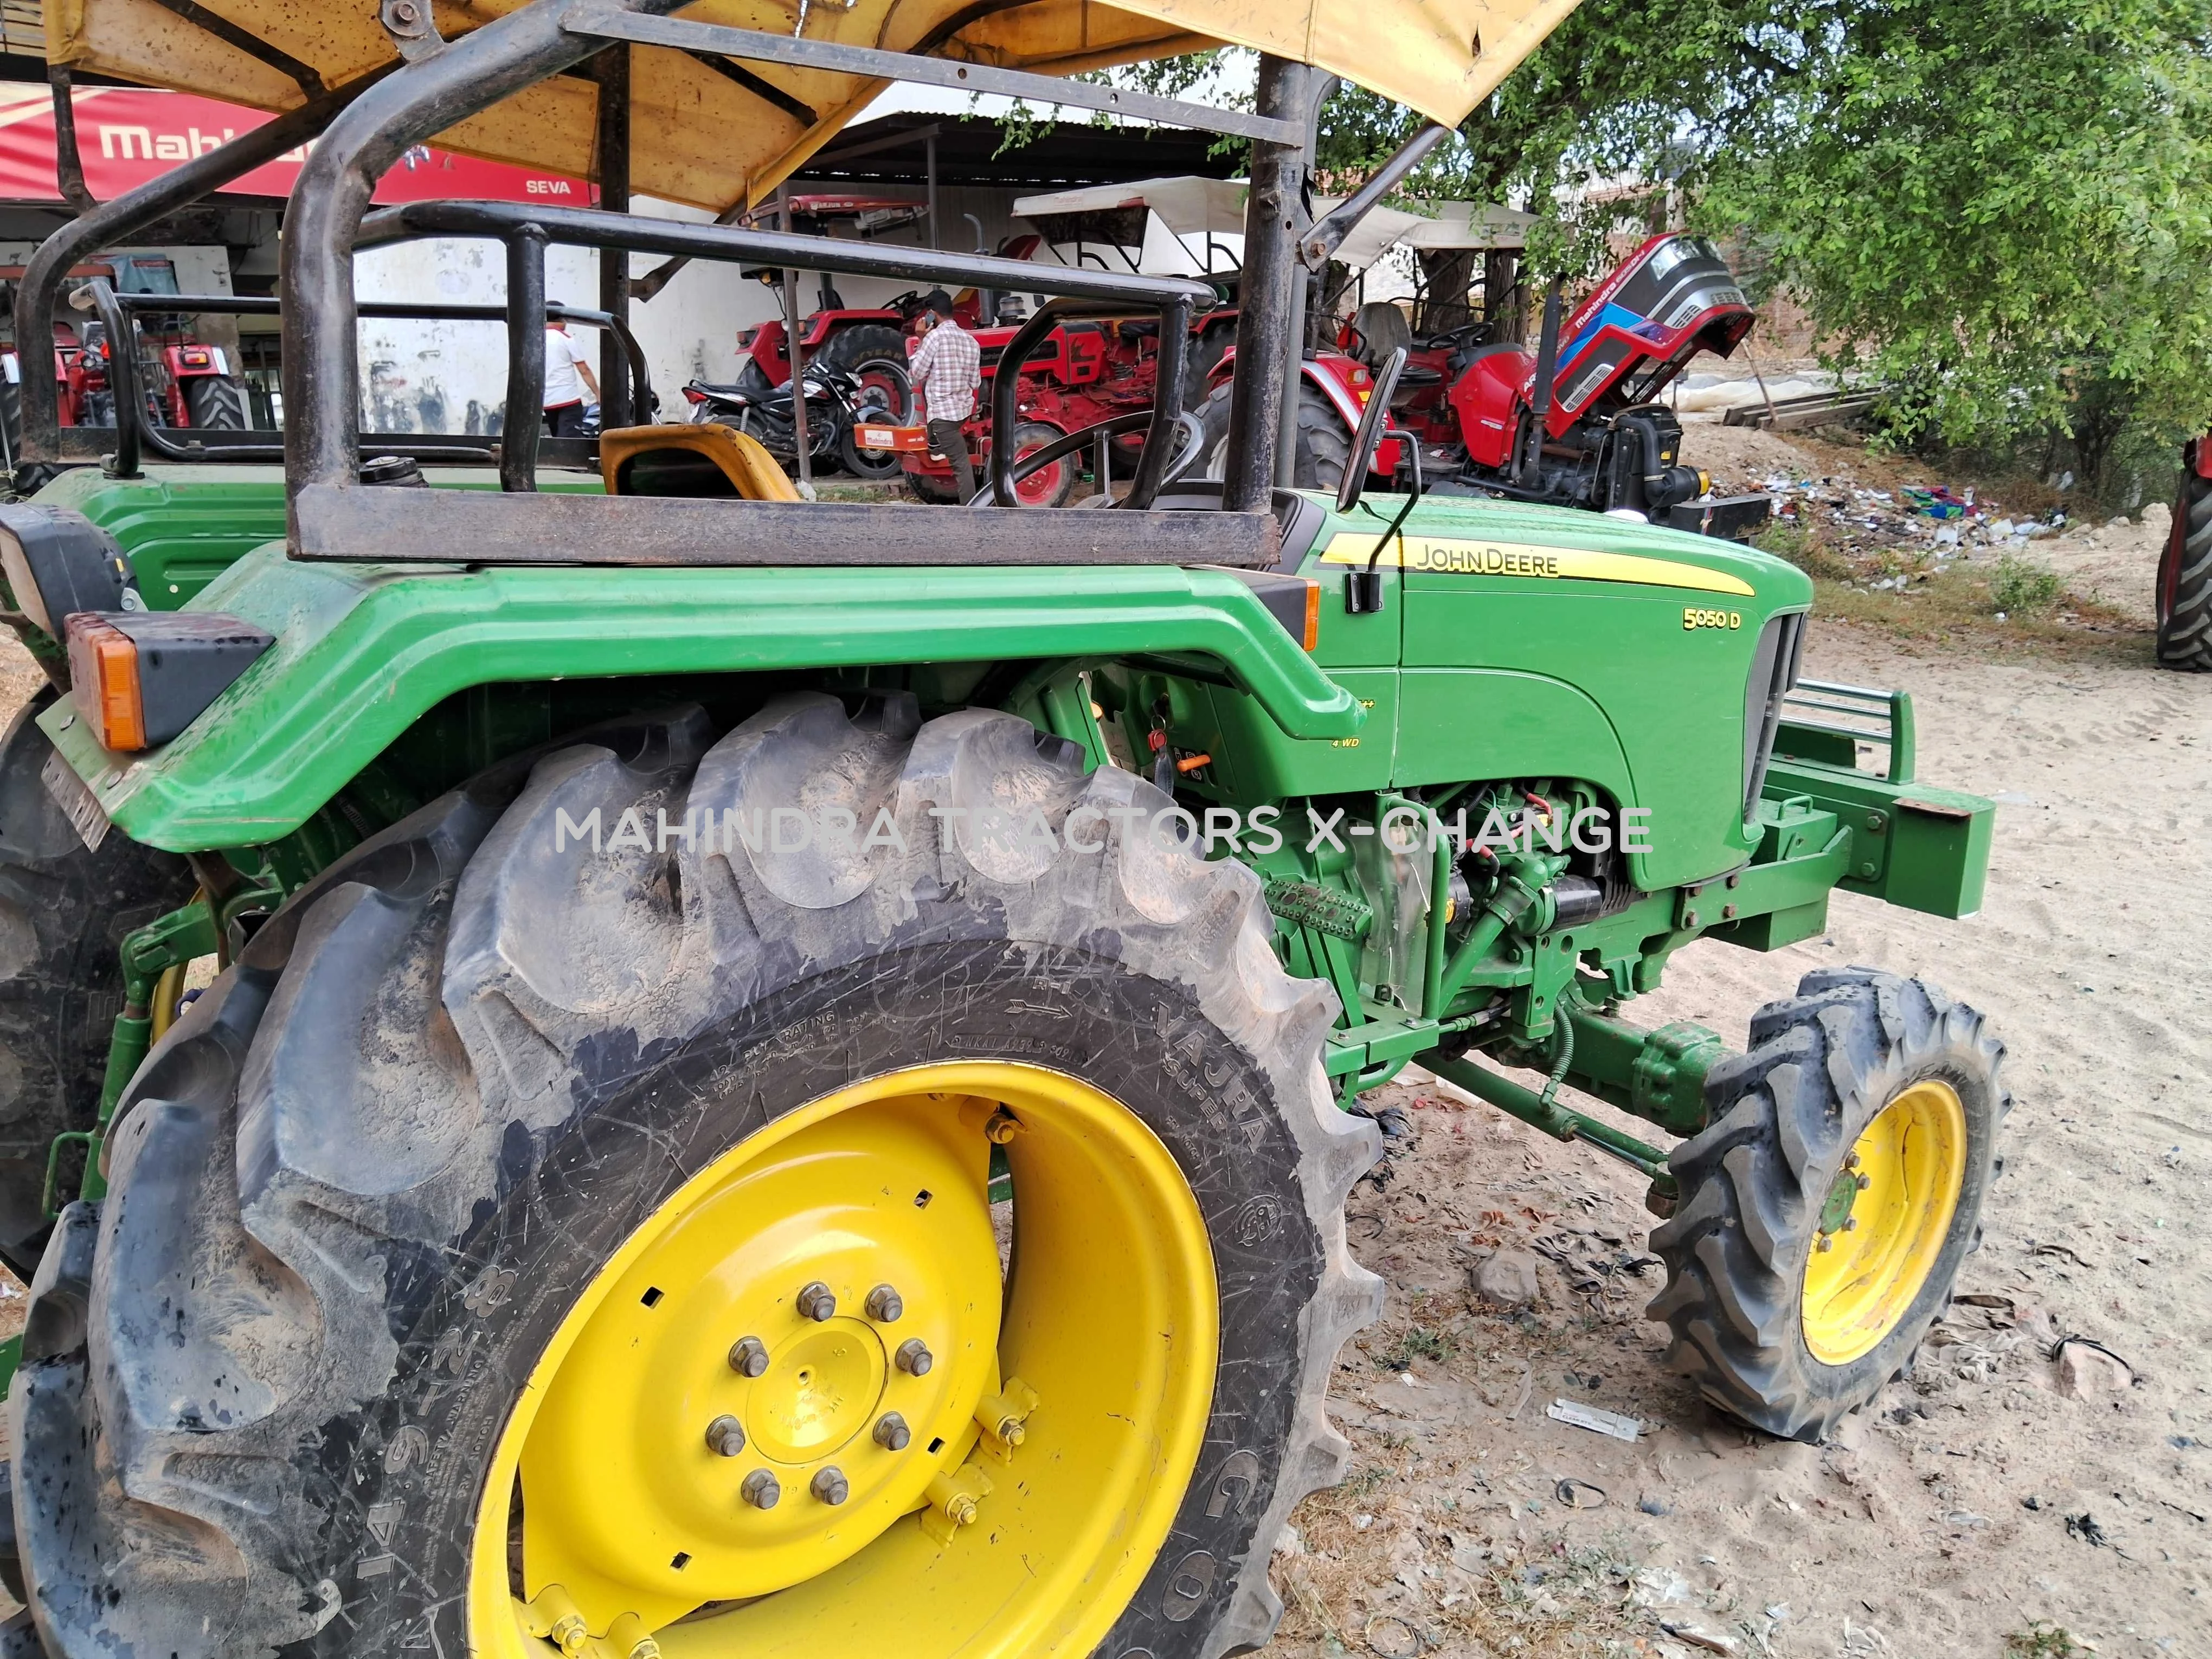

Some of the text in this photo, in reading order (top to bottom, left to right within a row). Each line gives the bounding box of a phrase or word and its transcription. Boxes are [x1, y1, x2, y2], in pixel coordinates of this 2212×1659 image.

[526, 180, 571, 194] SEVA
[1574, 281, 1617, 329] Mahindra
[1417, 543, 1559, 575] JOHN DEERE
[1682, 607, 1742, 631] 5050 D
[1332, 737, 1360, 748] 4 WD
[780, 1011, 835, 1041] RATING
[1155, 1000, 1268, 1155] VAJRA
[1162, 1057, 1227, 1134] SUPER
[1181, 1133, 1203, 1161] NOTCH
[447, 1357, 485, 1425] WARNING
[469, 1413, 494, 1461] NOTCH
